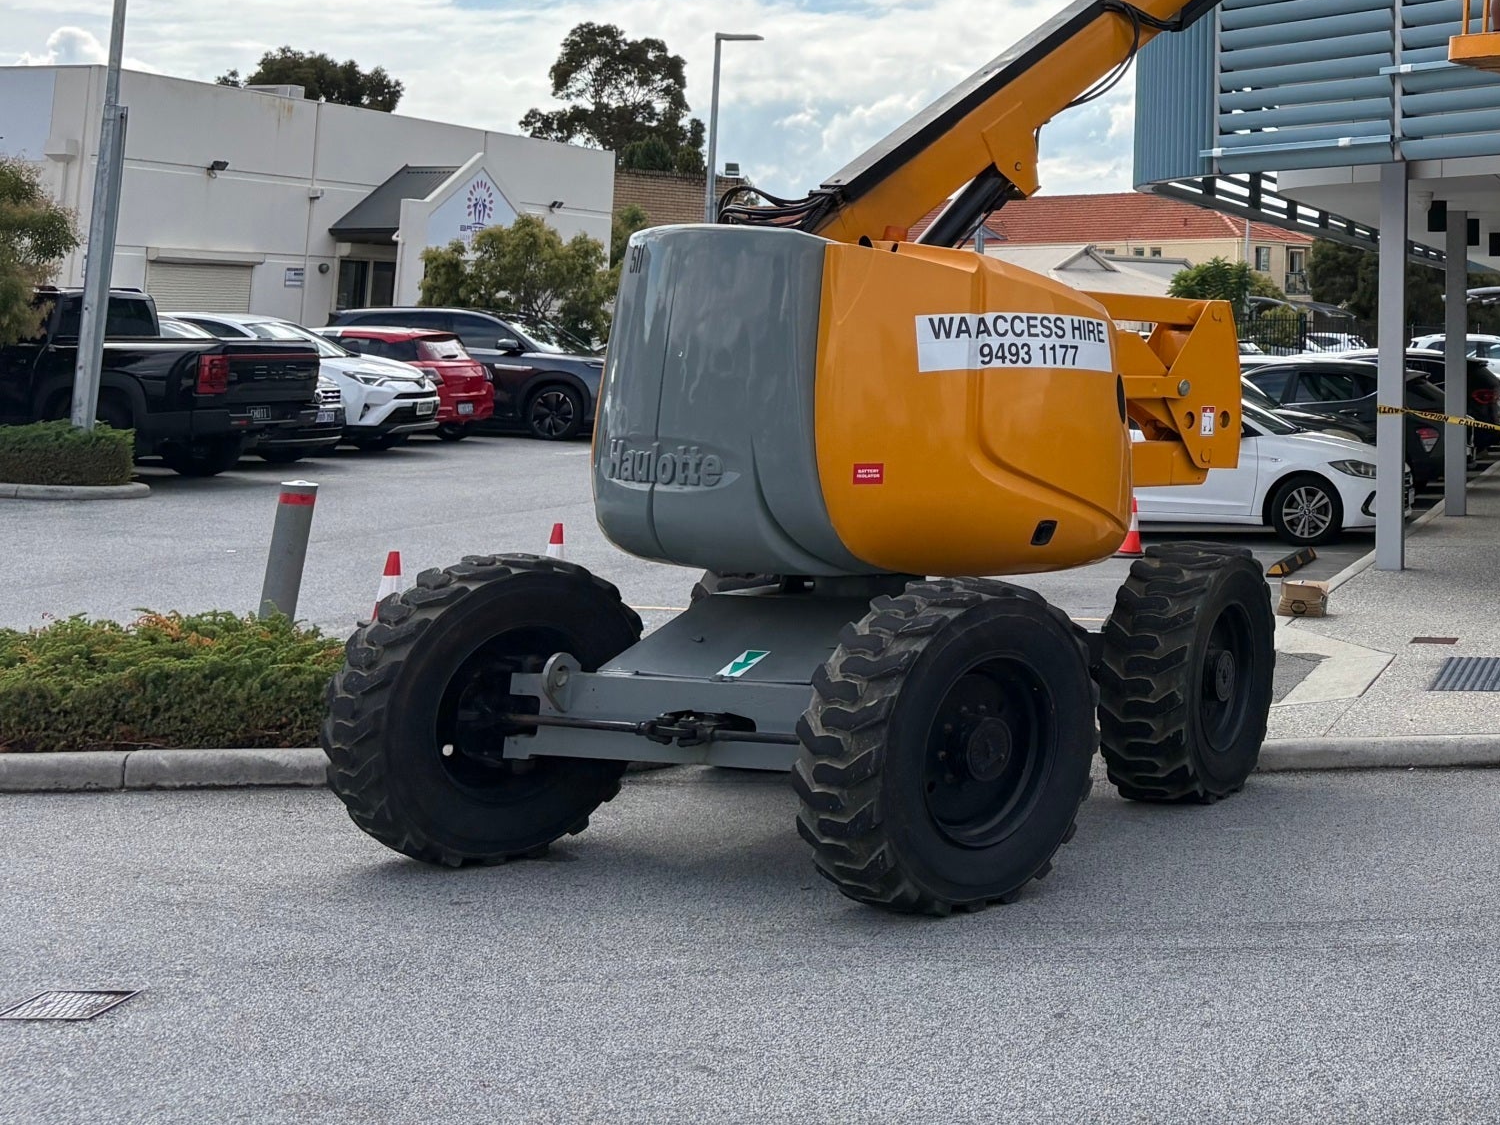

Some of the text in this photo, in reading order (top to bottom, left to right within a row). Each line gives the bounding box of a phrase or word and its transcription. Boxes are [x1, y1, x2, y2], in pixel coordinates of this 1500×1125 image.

[975, 315, 1066, 339] ACCESS
[1071, 318, 1105, 343] HIRE
[979, 343, 1079, 366] 9493 1177
[608, 438, 723, 487] Haulotte
